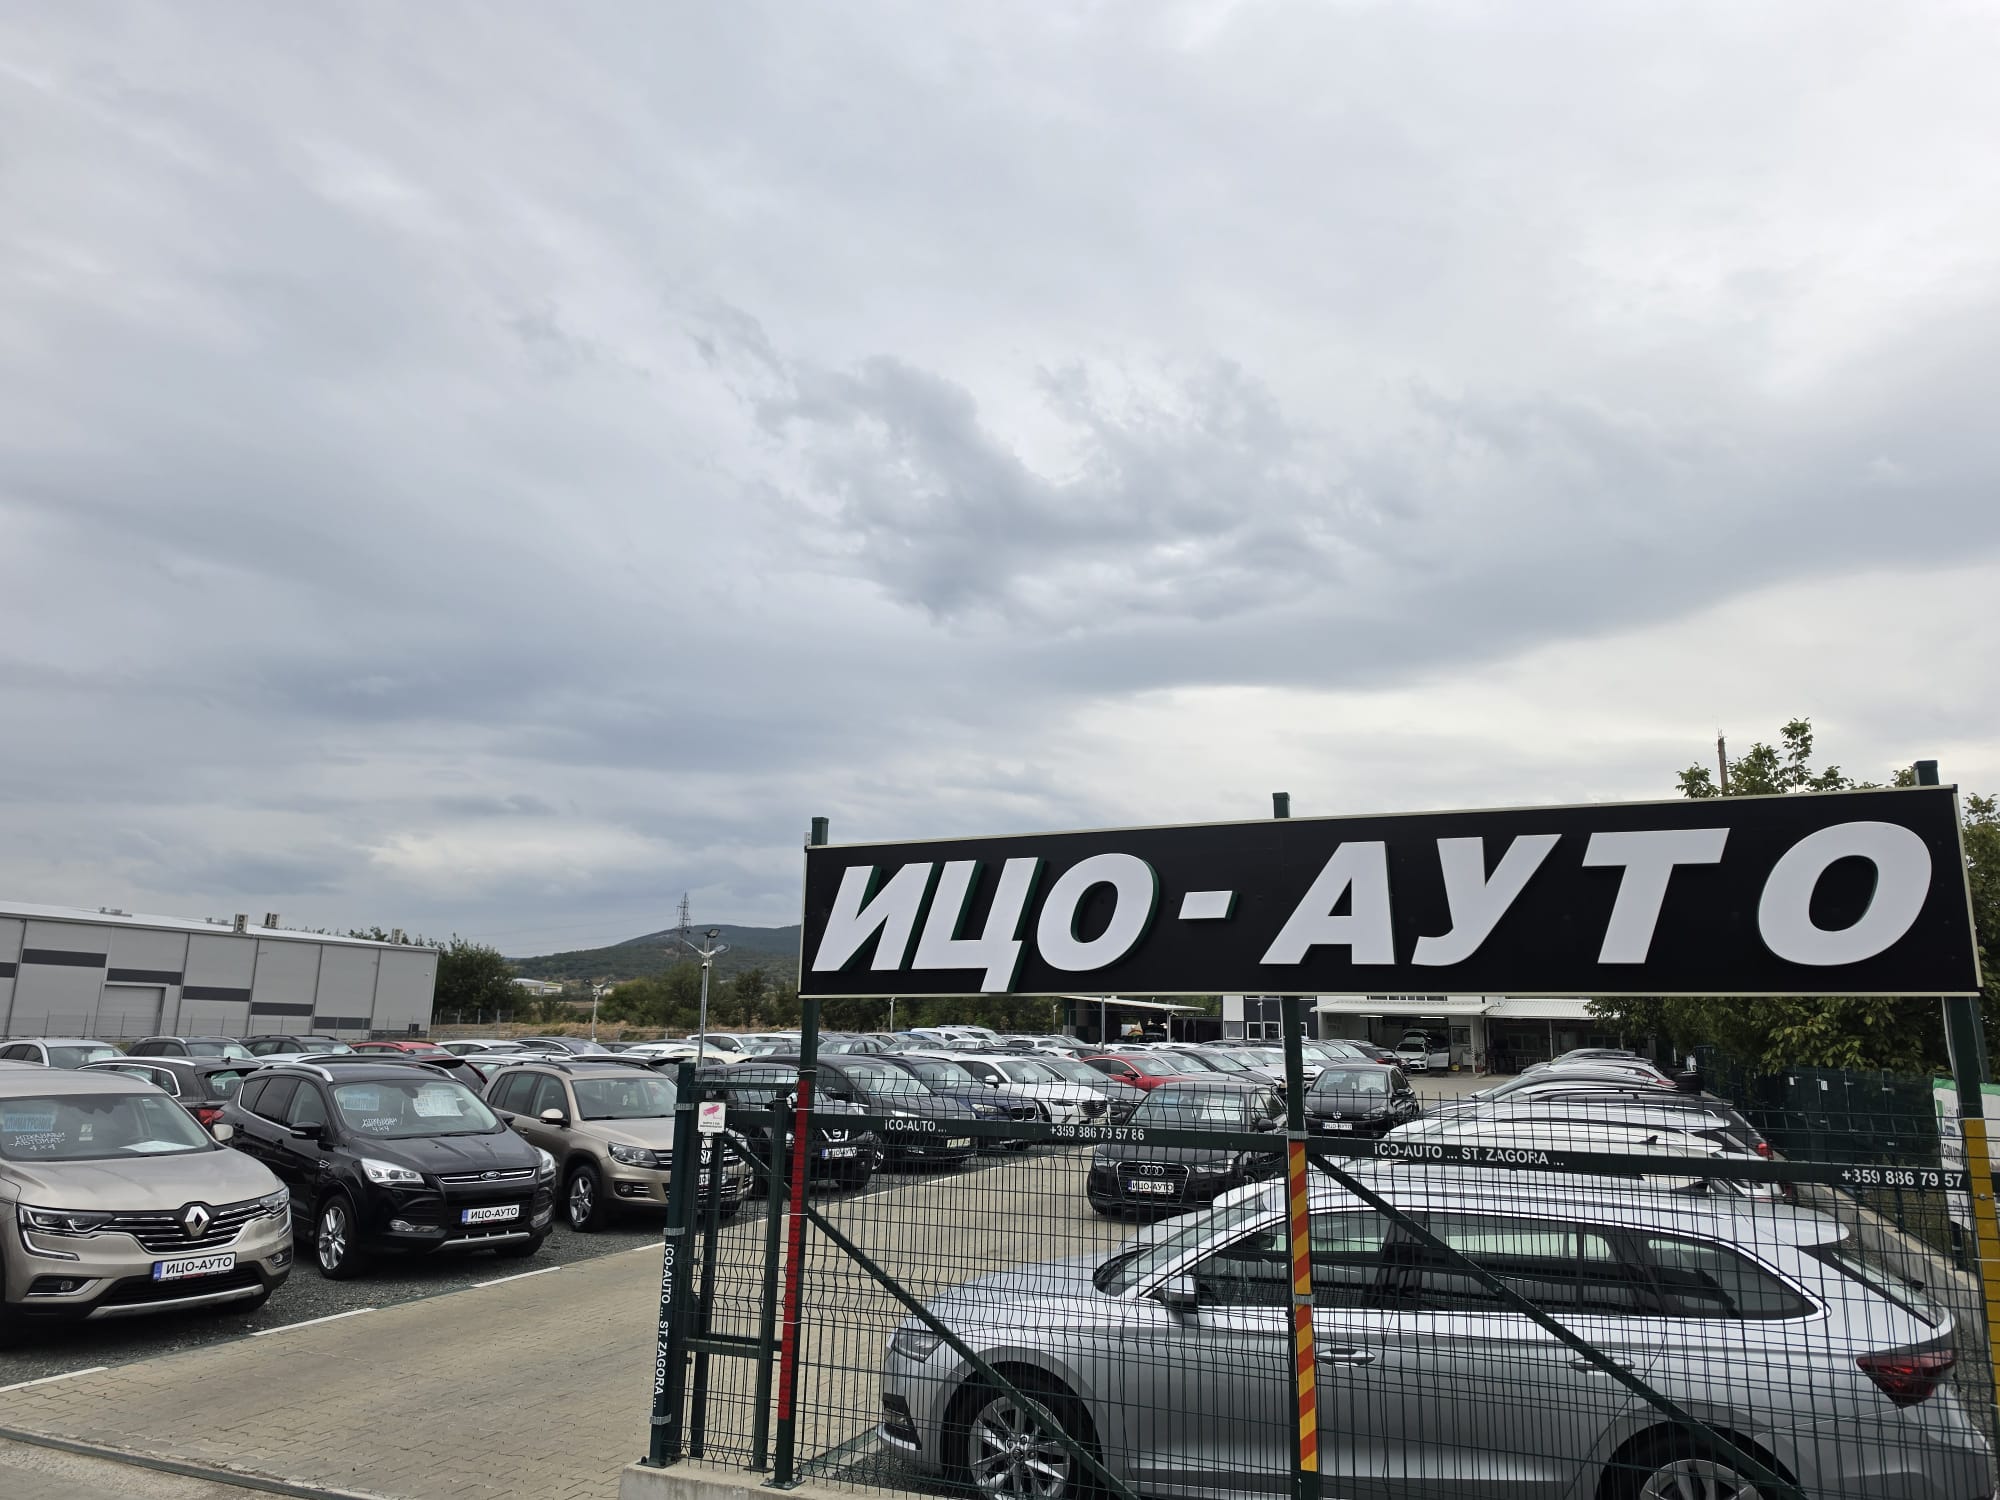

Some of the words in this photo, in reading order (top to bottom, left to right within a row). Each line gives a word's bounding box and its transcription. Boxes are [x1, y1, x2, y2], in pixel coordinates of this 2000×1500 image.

[812, 852, 1158, 993] ИЦО
[1259, 821, 1933, 967] АУТО
[1050, 1125, 1075, 1137] +359
[1099, 1127, 1113, 1139] 79
[1115, 1128, 1128, 1140] 57
[1131, 1128, 1145, 1140] 86
[1461, 1147, 1483, 1161] ST.
[1485, 1149, 1550, 1165] ZAGORA
[1841, 1168, 1881, 1184] +359
[1885, 1170, 1915, 1186] 886
[1919, 1171, 1939, 1187] 79
[1944, 1173, 1963, 1188] 57
[470, 1207, 518, 1220] ИЦО-АУТО
[166, 1256, 232, 1275] ИЦО-АУТО
[658, 1320, 669, 1338] ST.
[654, 1341, 668, 1395] ZAGORA
